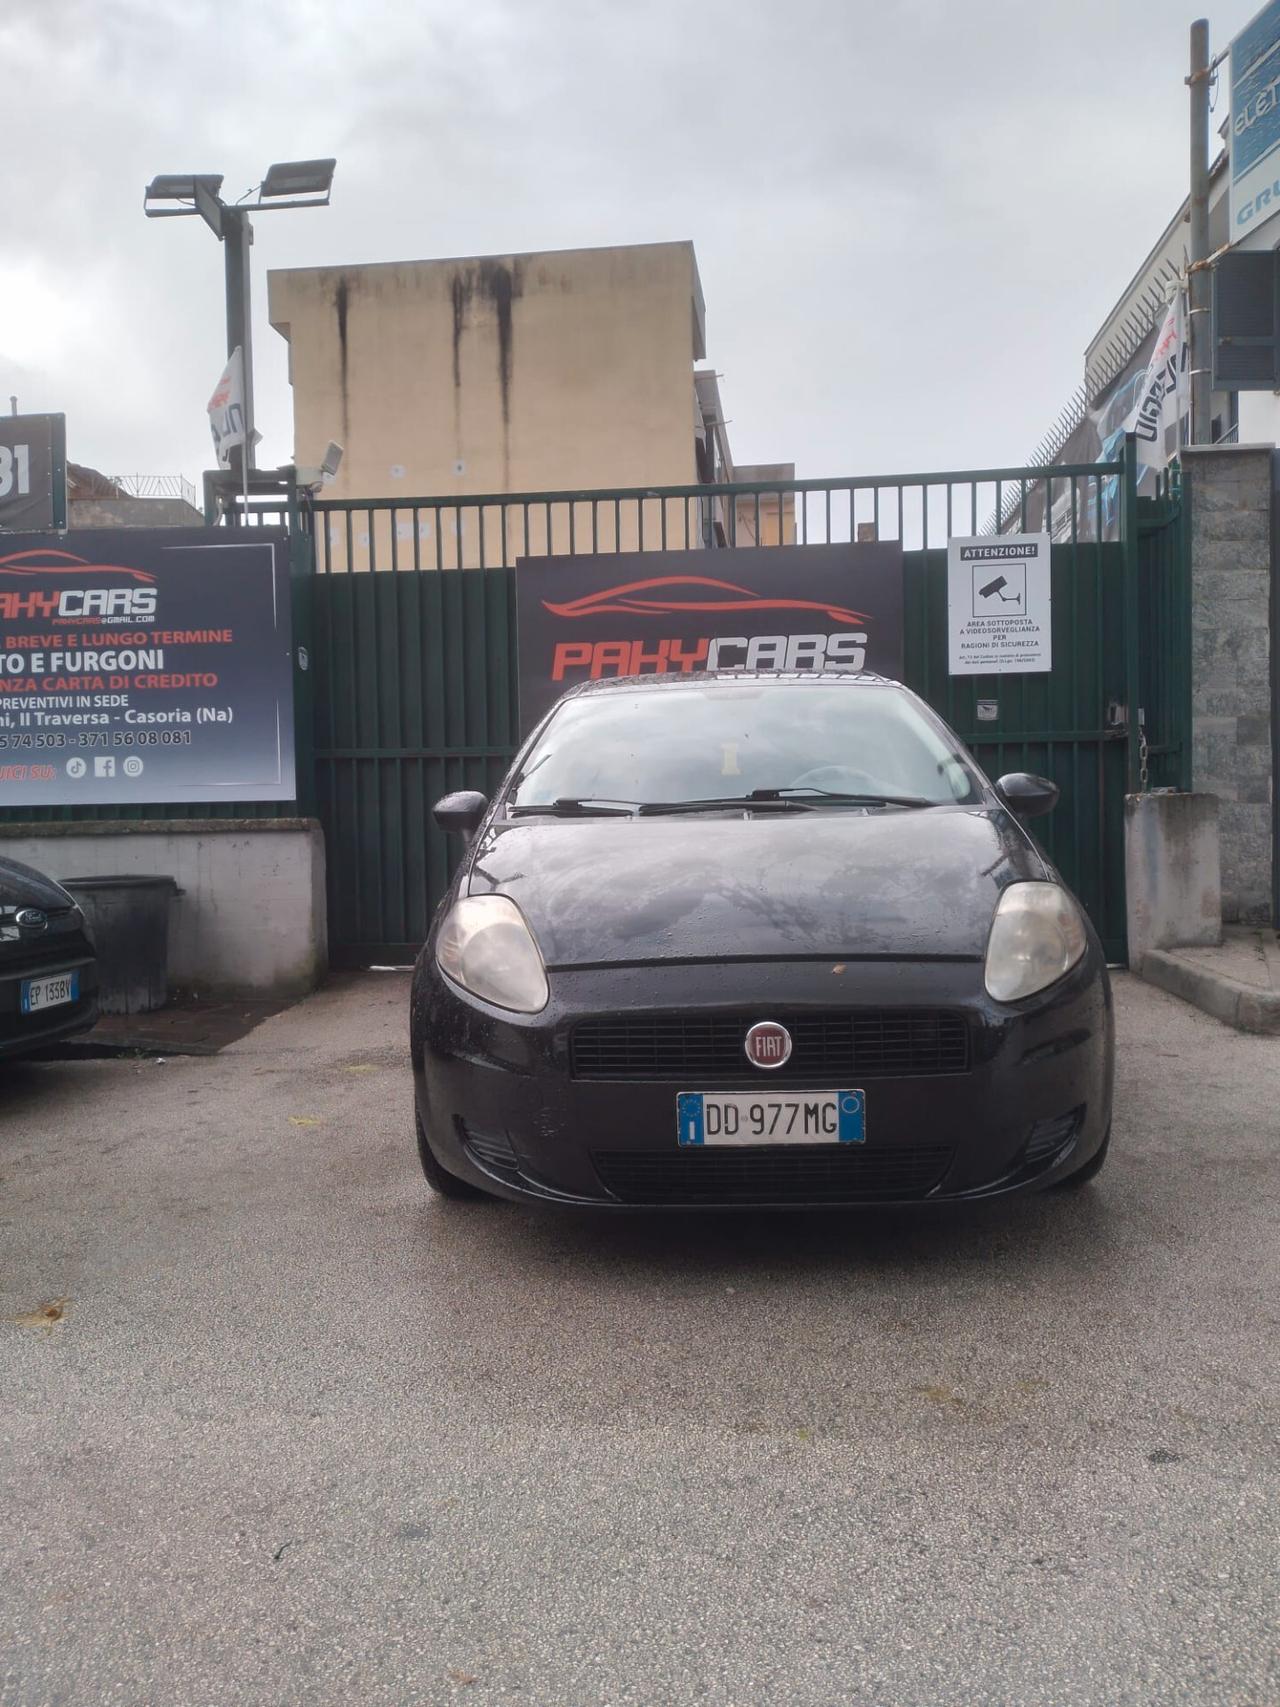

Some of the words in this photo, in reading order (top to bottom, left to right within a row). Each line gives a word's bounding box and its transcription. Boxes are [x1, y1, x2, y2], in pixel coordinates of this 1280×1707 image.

[963, 546, 1036, 559] ATTENZIONE!
[5, 634, 63, 649] BREVE
[67, 633, 78, 647] E
[82, 631, 148, 647] LUNGO
[151, 629, 233, 645] TERMINE
[966, 626, 1040, 635] VIDEOSORVEGLIANZA
[961, 641, 990, 649] RAGIONI
[1000, 640, 1039, 648] SICUREZZA
[31, 652, 45, 673] E
[50, 649, 164, 673] FURGONI
[0, 677, 37, 692] NZA
[42, 675, 104, 692] CARTA
[109, 675, 129, 689] DI
[134, 672, 219, 688] CREDITO
[0, 696, 73, 710] REVENTIVI
[76, 695, 92, 708] IN
[94, 694, 129, 707] SEDE
[34, 710, 110, 726] Traversa
[124, 708, 192, 724] Casoria
[196, 706, 234, 724] (Na)
[11, 733, 32, 749] 74
[36, 732, 66, 748] 503
[78, 732, 109, 747] 371
[113, 731, 134, 747] 56
[137, 731, 157, 746] 08
[161, 730, 191, 746] 081
[30, 985, 41, 1006] EP
[755, 1036, 782, 1057] FIAT
[706, 1104, 740, 1136] DD
[750, 1102, 838, 1136] 977MG
